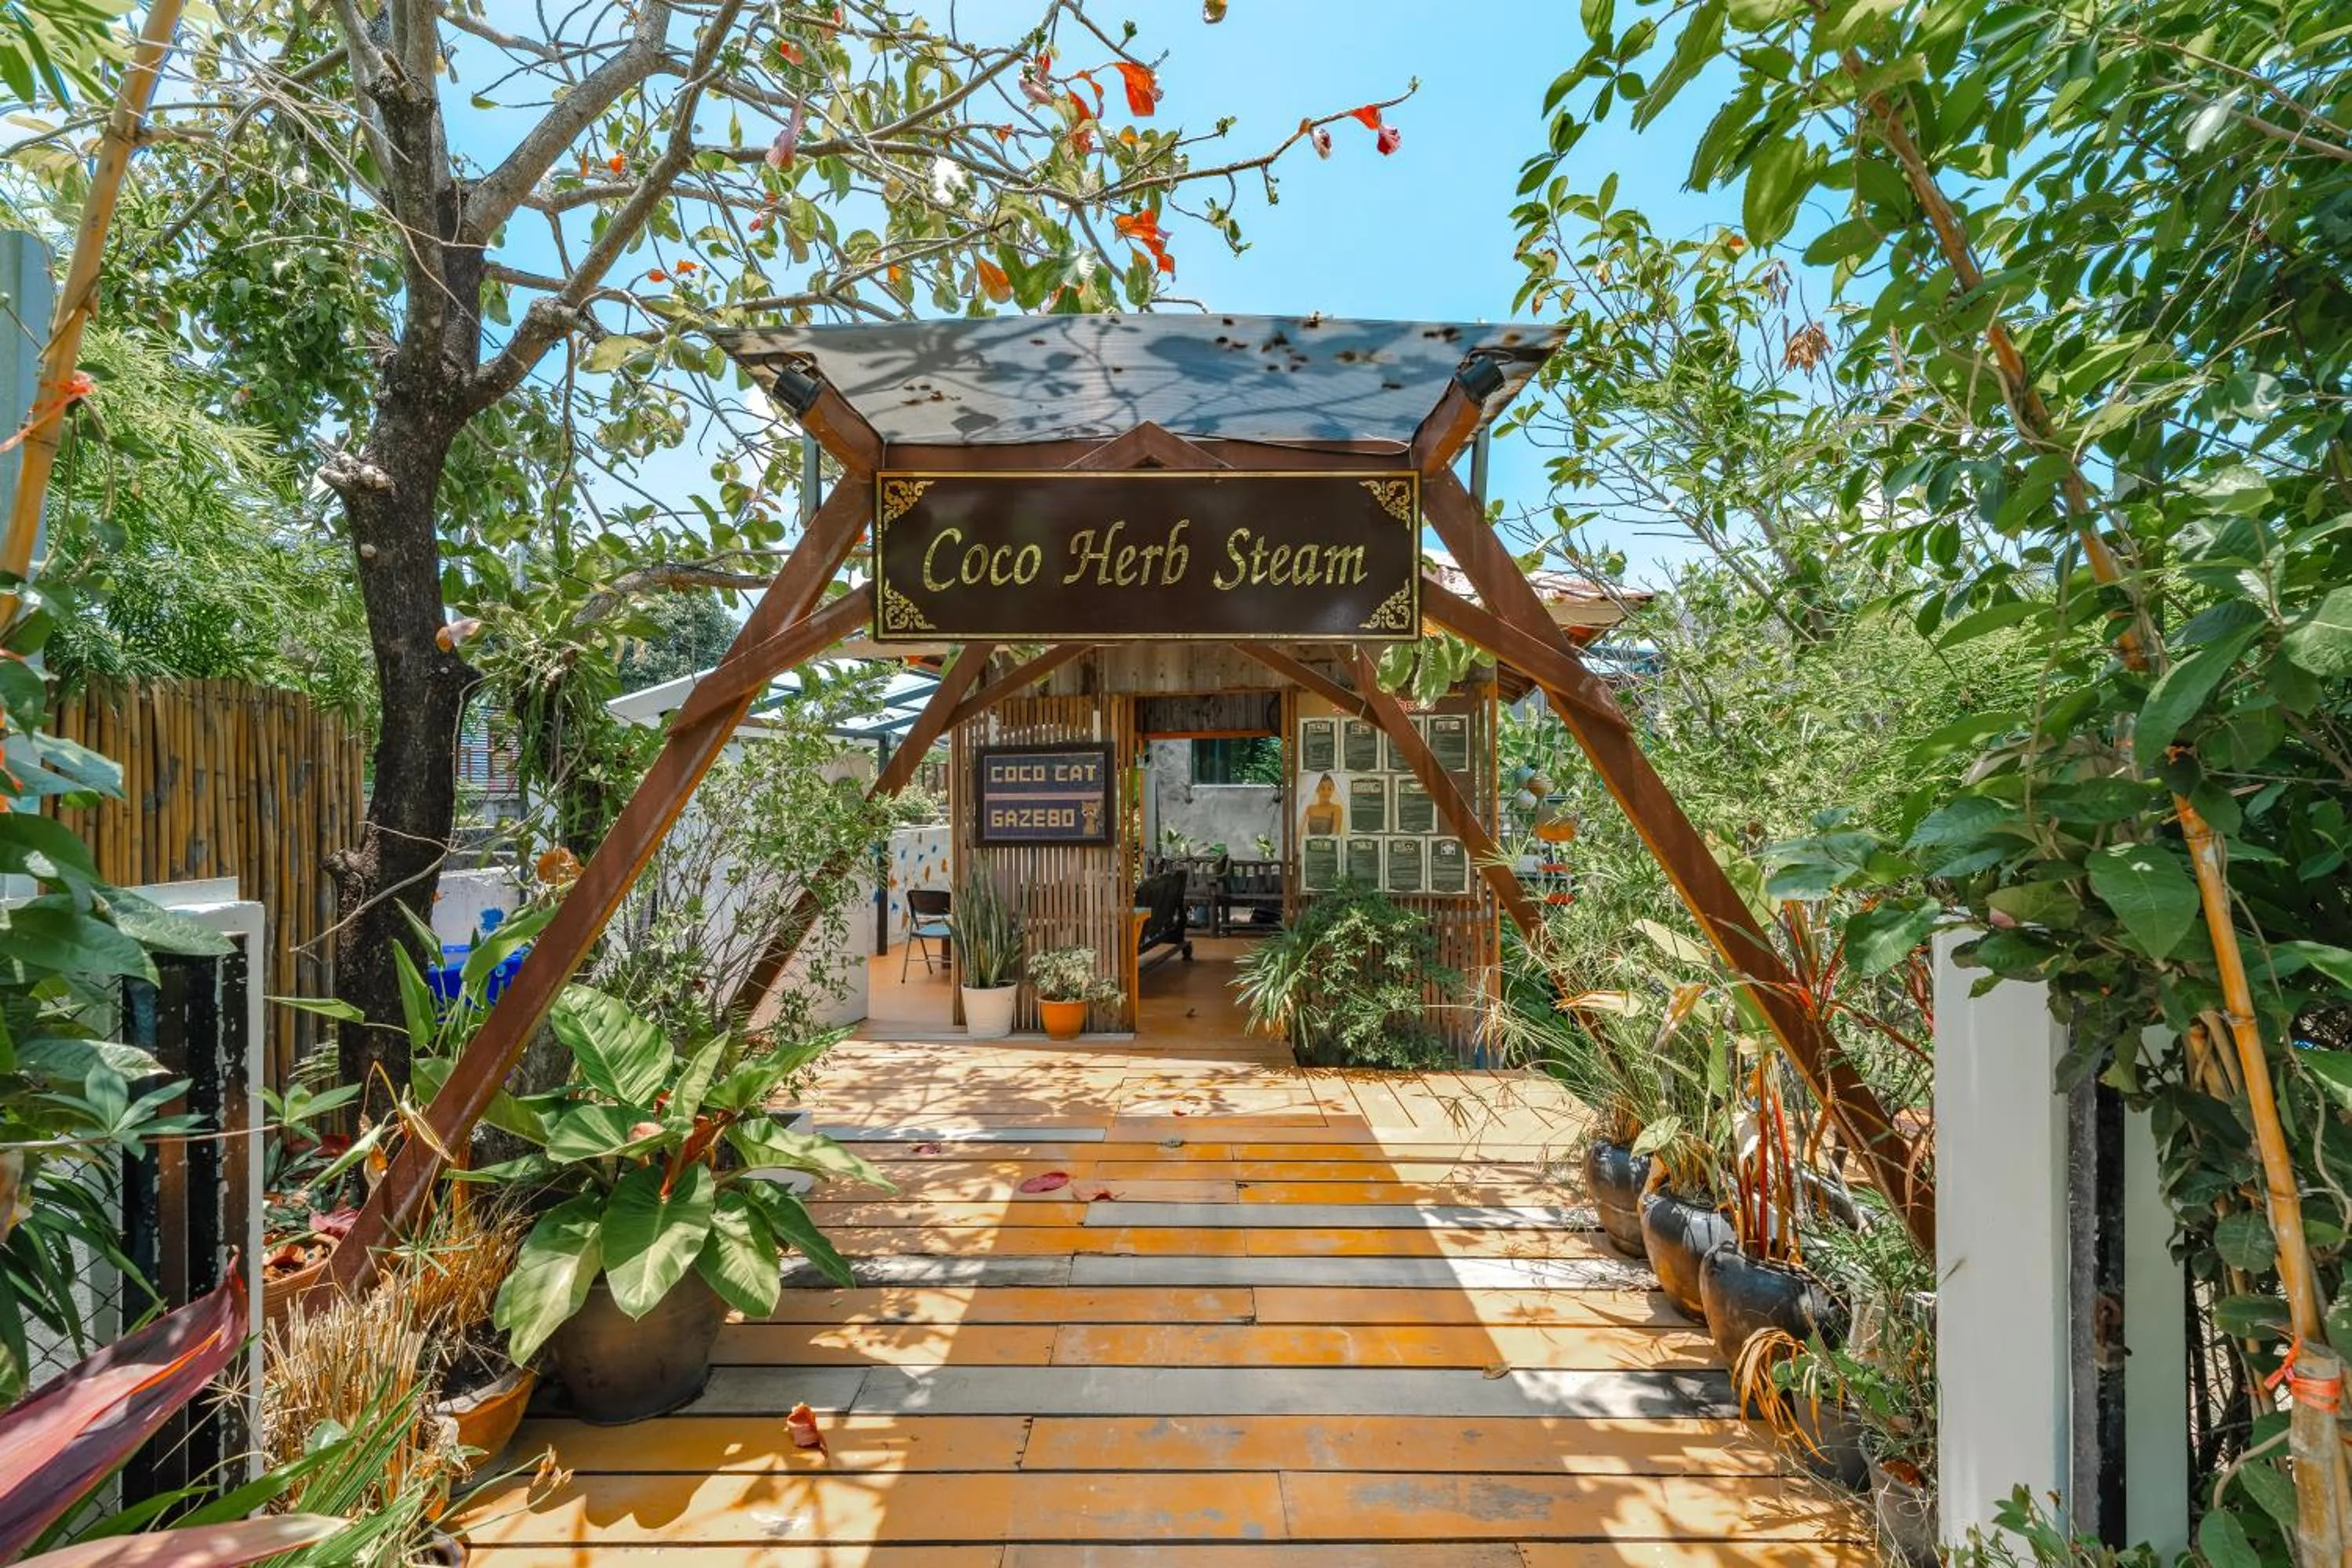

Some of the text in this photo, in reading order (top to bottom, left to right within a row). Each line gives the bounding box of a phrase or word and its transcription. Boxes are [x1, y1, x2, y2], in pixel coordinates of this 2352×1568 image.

[923, 519, 1368, 591] Coco Herb Steam
[991, 765, 1097, 782] COCO CAT
[991, 809, 1075, 827] GAZEBO
